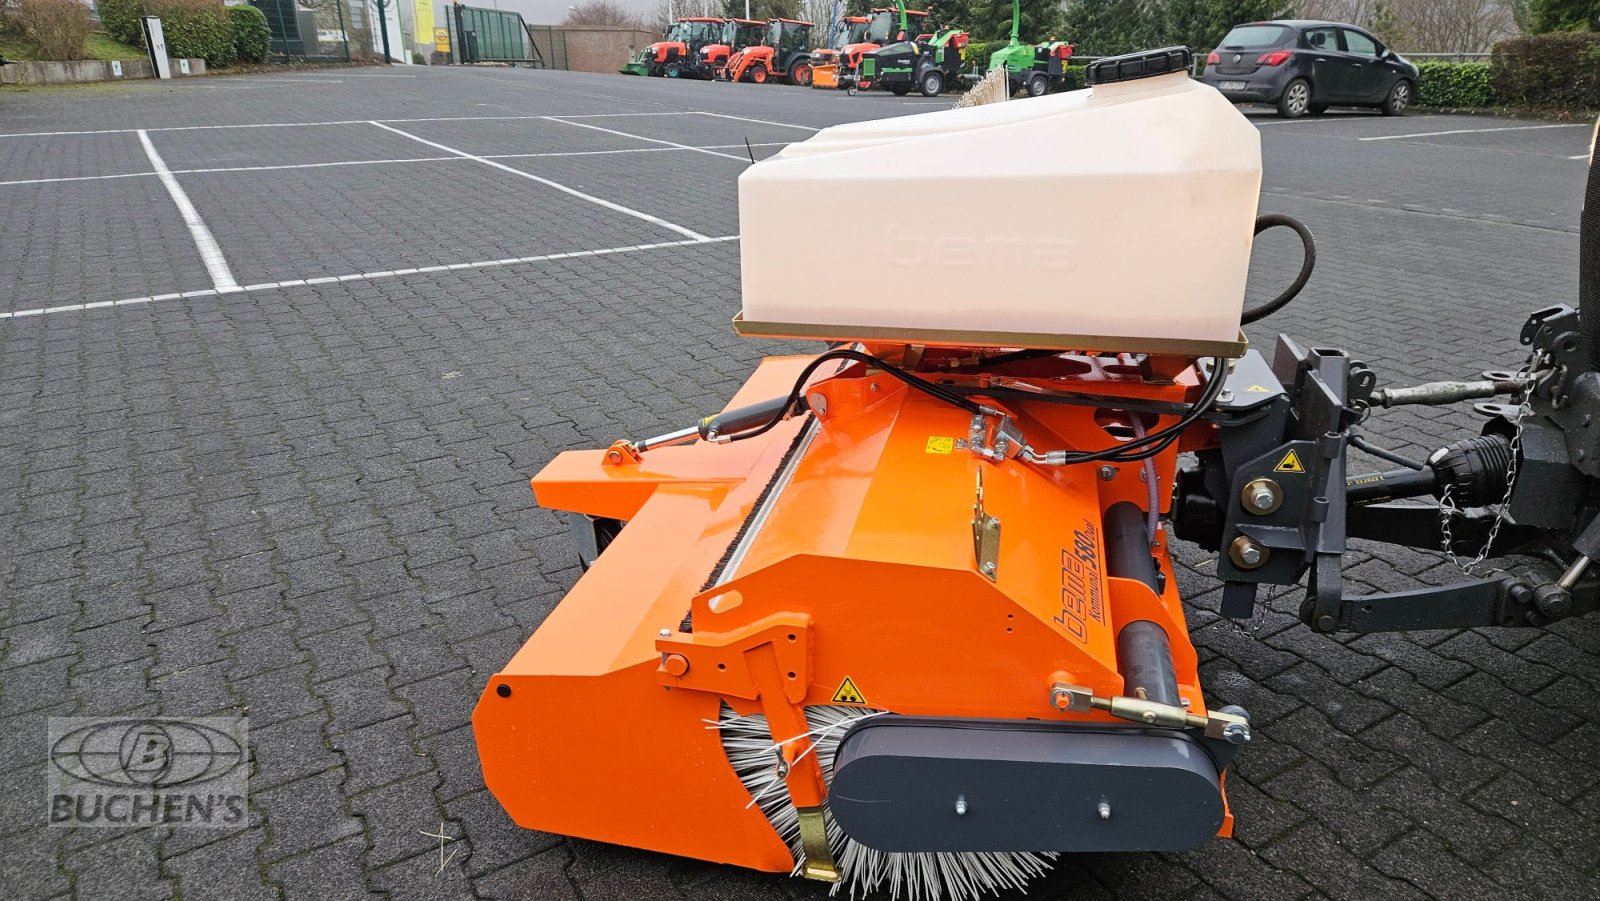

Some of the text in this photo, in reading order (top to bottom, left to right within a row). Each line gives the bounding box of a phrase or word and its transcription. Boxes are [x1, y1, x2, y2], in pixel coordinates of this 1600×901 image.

[888, 223, 1077, 271] bema
[1053, 549, 1087, 644] bema
[1073, 518, 1101, 622] Kommunal 580 Dual
